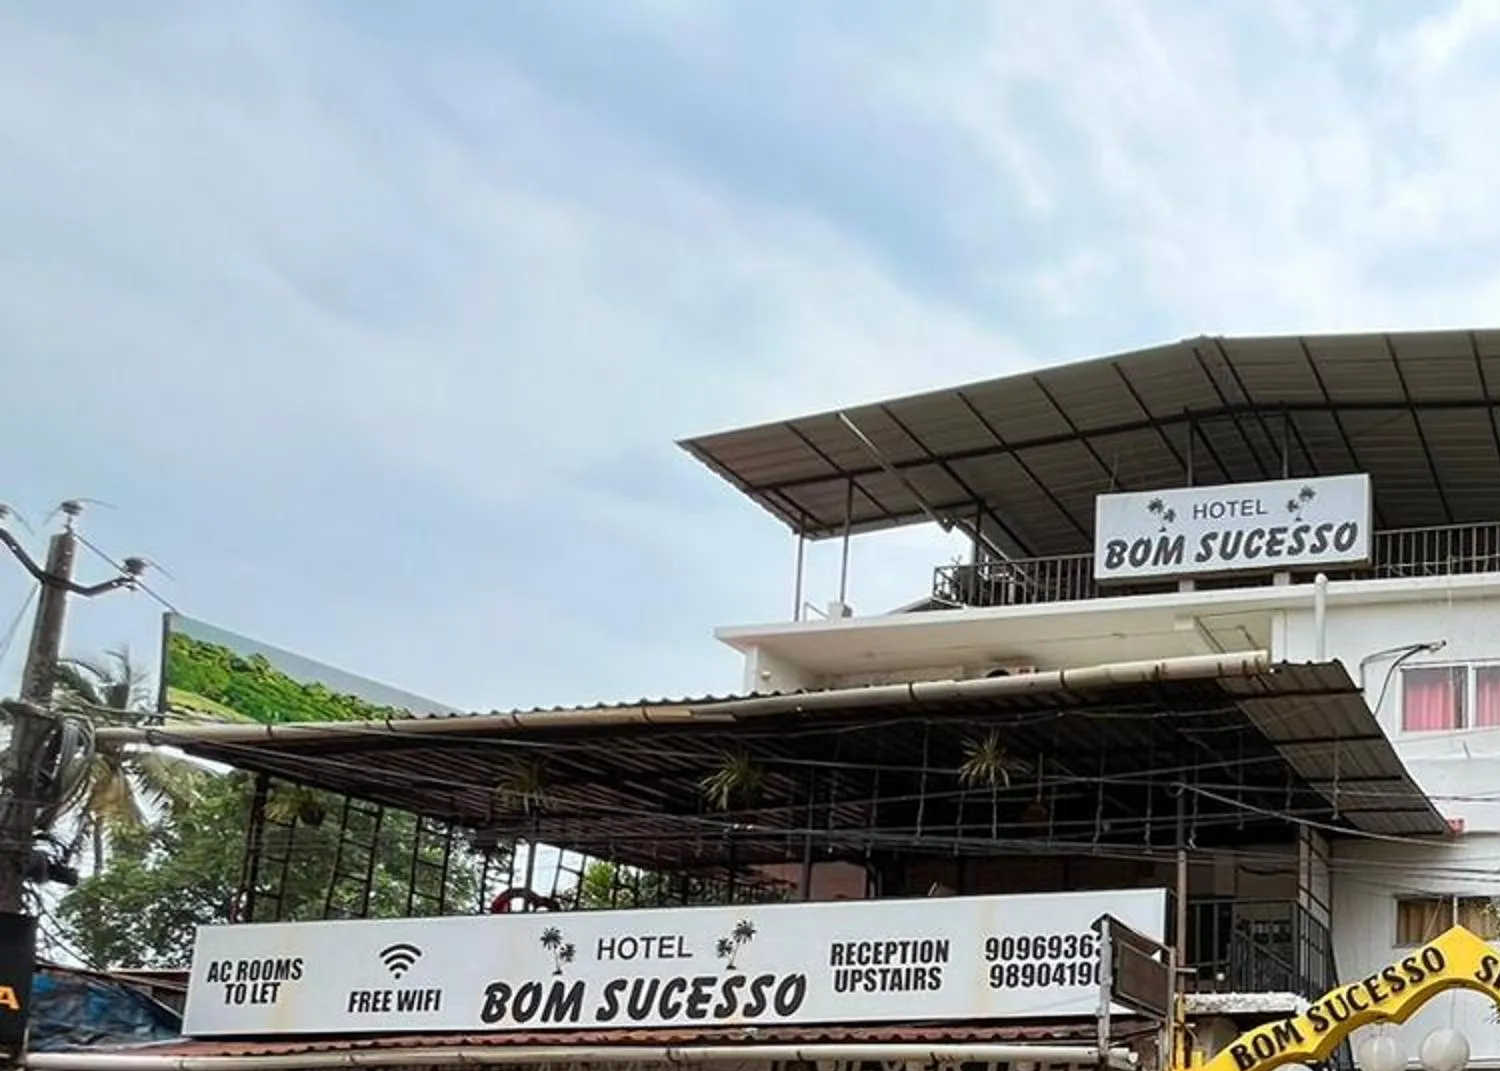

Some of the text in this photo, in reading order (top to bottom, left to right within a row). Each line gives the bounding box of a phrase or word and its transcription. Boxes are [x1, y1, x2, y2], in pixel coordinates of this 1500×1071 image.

[1193, 499, 1267, 520] HOTEL
[1104, 521, 1359, 570] BOM SUCESSO
[597, 935, 693, 961] HOTEL
[830, 939, 950, 966] RECEPTION
[207, 958, 304, 982] AC ROOMS
[833, 967, 943, 993] UPSTAIRS
[224, 982, 281, 1005] TO LET
[348, 989, 442, 1013] FREE WIFI
[481, 973, 806, 1024] BOM SUCESSO
[1306, 946, 1446, 1033] SUCESSO
